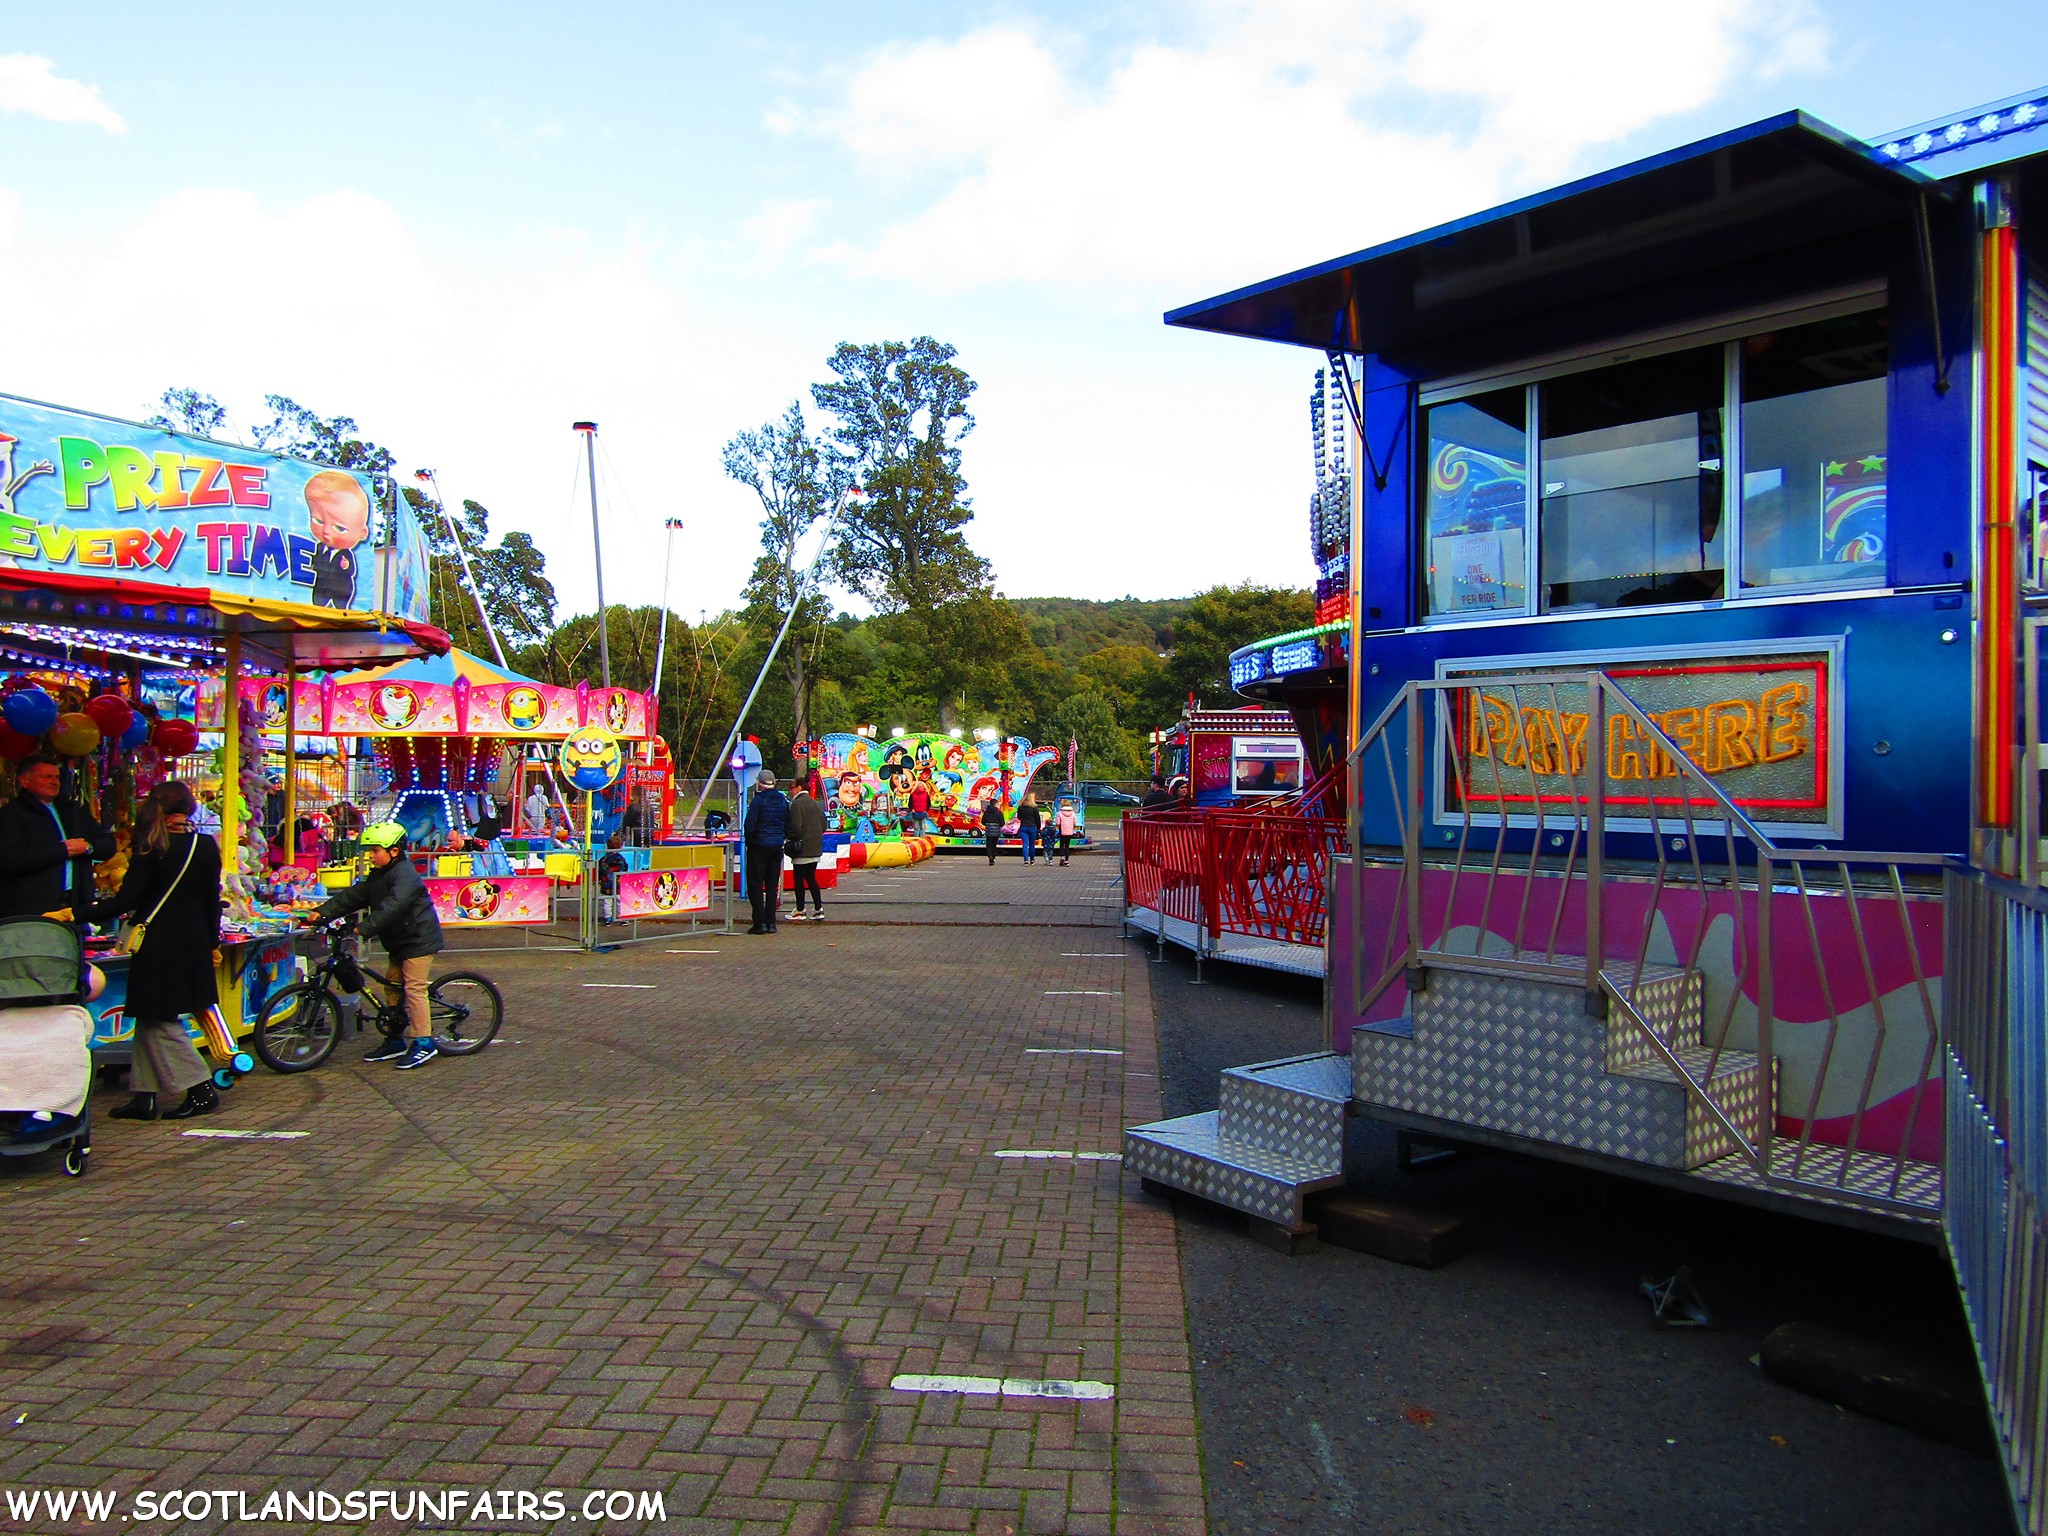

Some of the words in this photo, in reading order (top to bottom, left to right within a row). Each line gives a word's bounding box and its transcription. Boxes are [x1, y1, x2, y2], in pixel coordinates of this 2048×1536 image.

[58, 436, 271, 509] PRIZE
[0, 510, 185, 569] EVERY
[196, 522, 318, 586] TIME
[1467, 564, 1483, 574] ONE
[1461, 594, 1477, 605] PER
[1479, 592, 1496, 603] RIDE
[1464, 574, 1490, 585] TOKEN
[1470, 693, 1590, 775] PAY
[1607, 682, 1808, 779] HERE
